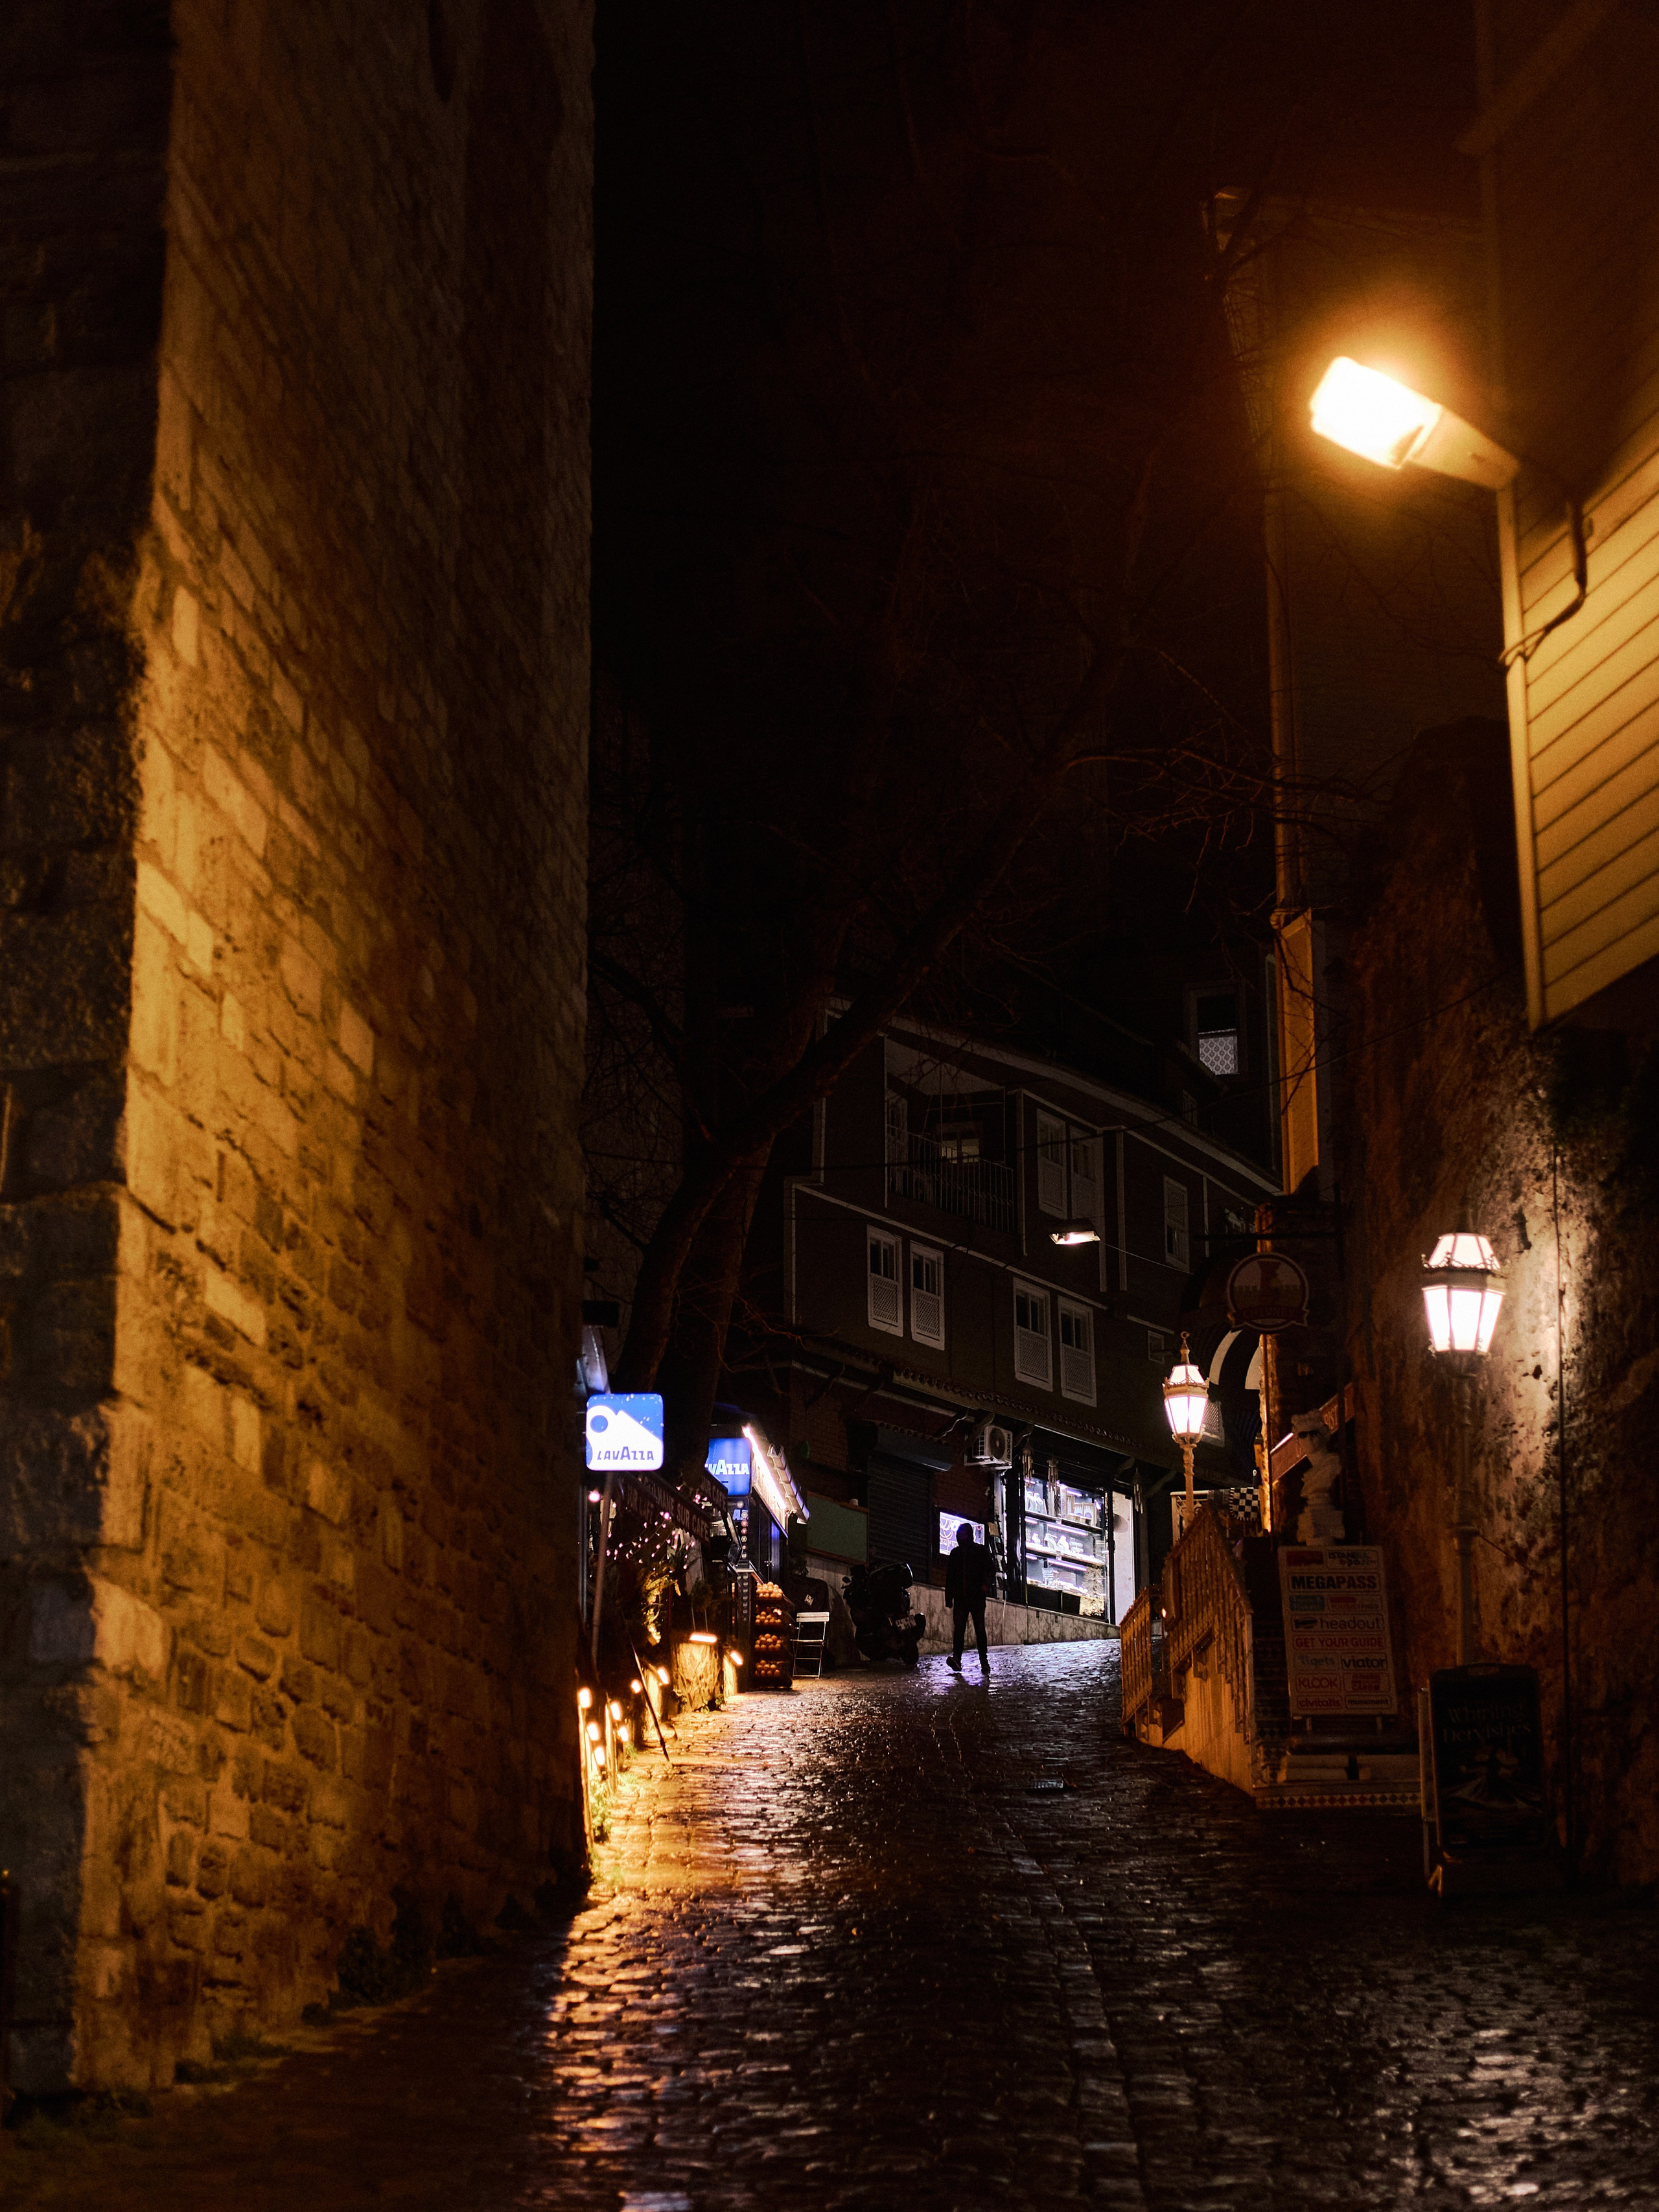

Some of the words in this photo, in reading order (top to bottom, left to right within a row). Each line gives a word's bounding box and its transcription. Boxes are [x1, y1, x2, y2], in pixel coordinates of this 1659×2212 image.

[597, 1446, 654, 1461] LAVAZZA
[704, 1459, 750, 1475] VAZZA
[1291, 1576, 1376, 1589] MEGAPASS
[1320, 1617, 1380, 1629] headout
[1296, 1637, 1315, 1647] GET
[1319, 1637, 1349, 1647] YOUR
[1351, 1636, 1382, 1647] GUIDE
[1341, 1656, 1387, 1668] viator
[1298, 1677, 1338, 1689] KLOOK
